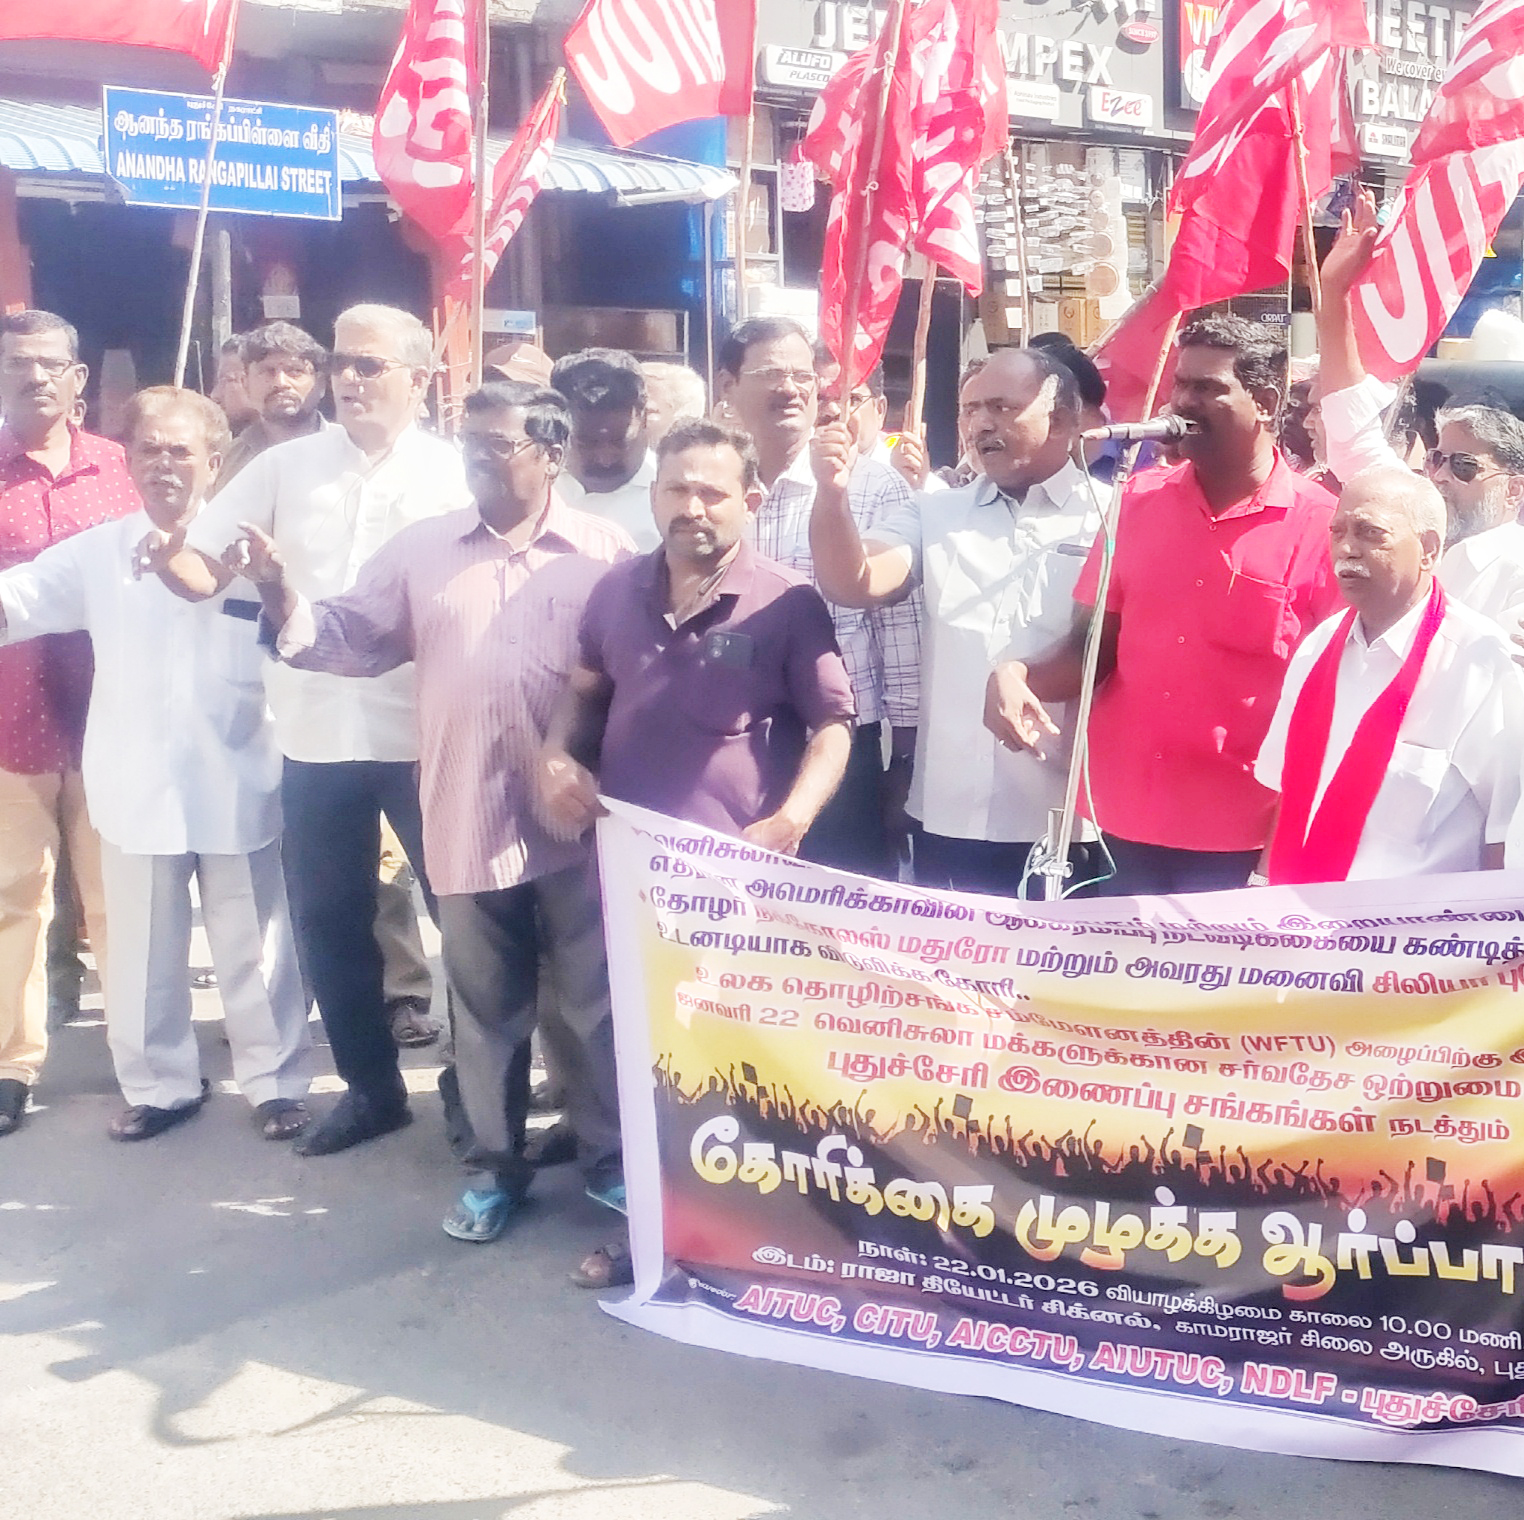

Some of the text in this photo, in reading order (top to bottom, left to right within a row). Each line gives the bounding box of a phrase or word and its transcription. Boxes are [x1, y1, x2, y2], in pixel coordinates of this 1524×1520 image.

[780, 49, 830, 69] ALUFO
[113, 108, 333, 156] ஆனந்த ரங்கப்பிள்ளை வீதி
[116, 151, 332, 195] ANANDHA RANGAPILLAI STREET
[657, 921, 813, 958] உடனடியாக
[897, 934, 1010, 965] மதுரோ
[1016, 945, 1118, 977] மற்றும்
[1125, 957, 1233, 991] அவரது
[1239, 965, 1364, 994] மனைவி
[676, 990, 751, 1023] ஜனவரி
[758, 1006, 800, 1029] 22
[814, 1012, 974, 1048] வெனிசுலா
[983, 1028, 1209, 1075] மக்களுக்கான
[1218, 1059, 1355, 1093] சர்வதேச
[1362, 1073, 1521, 1104] ஒற்றுமை
[696, 966, 774, 992] உலக
[1240, 1033, 1336, 1056] (WFTU)
[1345, 1039, 1502, 1070] அழைப்பிற்கு
[826, 1050, 1511, 1143] புதுச்சேரி இணைப்பு சங்கங்கள் நடத்தும்
[689, 1115, 996, 1238] கோரிக்கை
[1014, 1185, 1243, 1271] முழக்க
[751, 1244, 834, 1274] இடம்:
[841, 1262, 915, 1288] ராஜா
[922, 1272, 1034, 1311] தியேட்டர்
[1175, 1320, 1293, 1346] காமராஜர்
[1300, 1330, 1373, 1357] சிலை
[1379, 1341, 1485, 1374] அருகில்,
[857, 1238, 928, 1267] நாள்:
[931, 1255, 1099, 1298] 22.01.2026
[1105, 1283, 1282, 1321] வியாழக்கிழமை
[1289, 1309, 1372, 1330] காலை
[1379, 1314, 1452, 1341] 10.00
[733, 1284, 846, 1334] AITUC,
[853, 1301, 943, 1348] CITU,
[947, 1315, 1086, 1372] AICCTU,
[1089, 1339, 1234, 1396] AIUTUC,
[1240, 1360, 1338, 1404] NDLF
